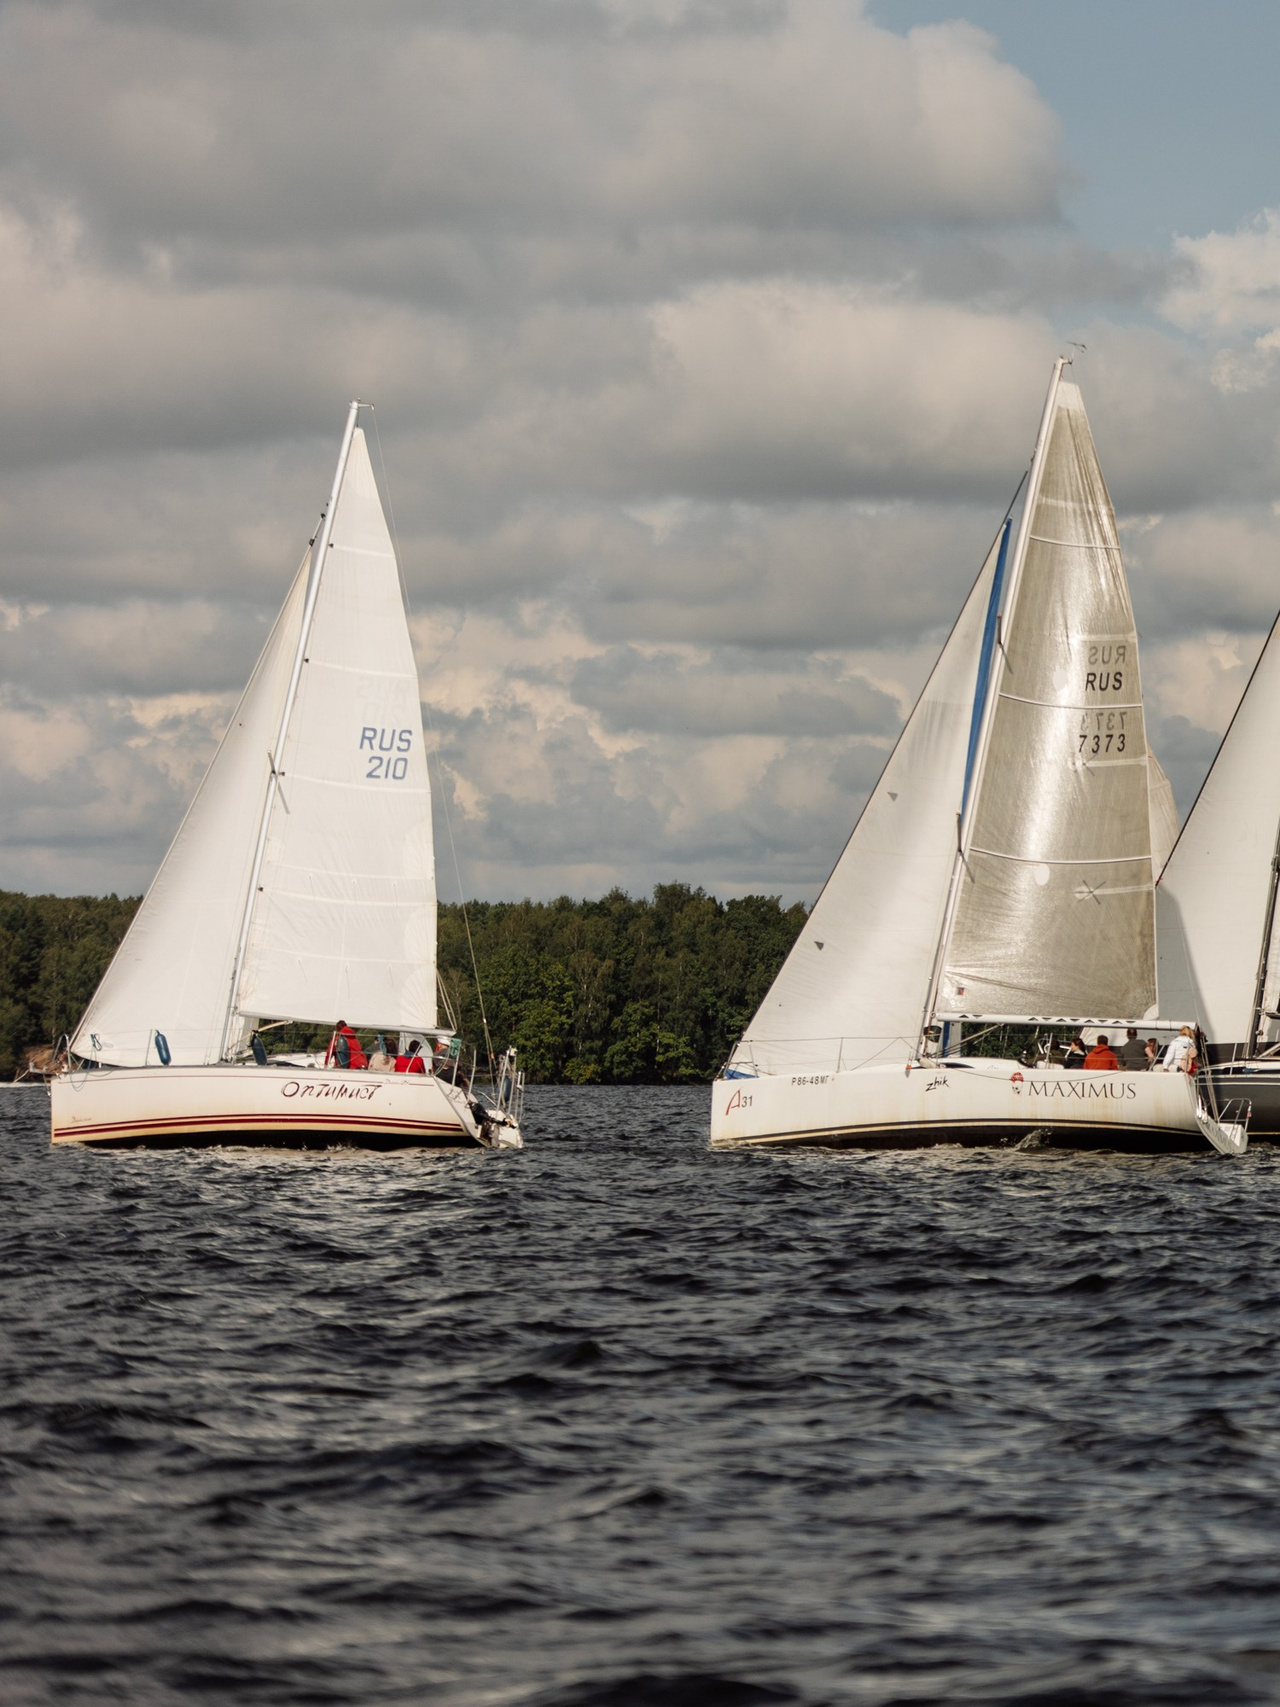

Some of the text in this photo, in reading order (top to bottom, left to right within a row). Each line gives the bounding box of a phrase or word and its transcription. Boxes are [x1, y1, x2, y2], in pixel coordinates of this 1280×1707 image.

[1085, 671, 1123, 691] RUS
[359, 726, 413, 753] RUS
[1078, 733, 1126, 754] 7373
[366, 756, 409, 781] 210
[1028, 1081, 1137, 1099] MAXIMUS
